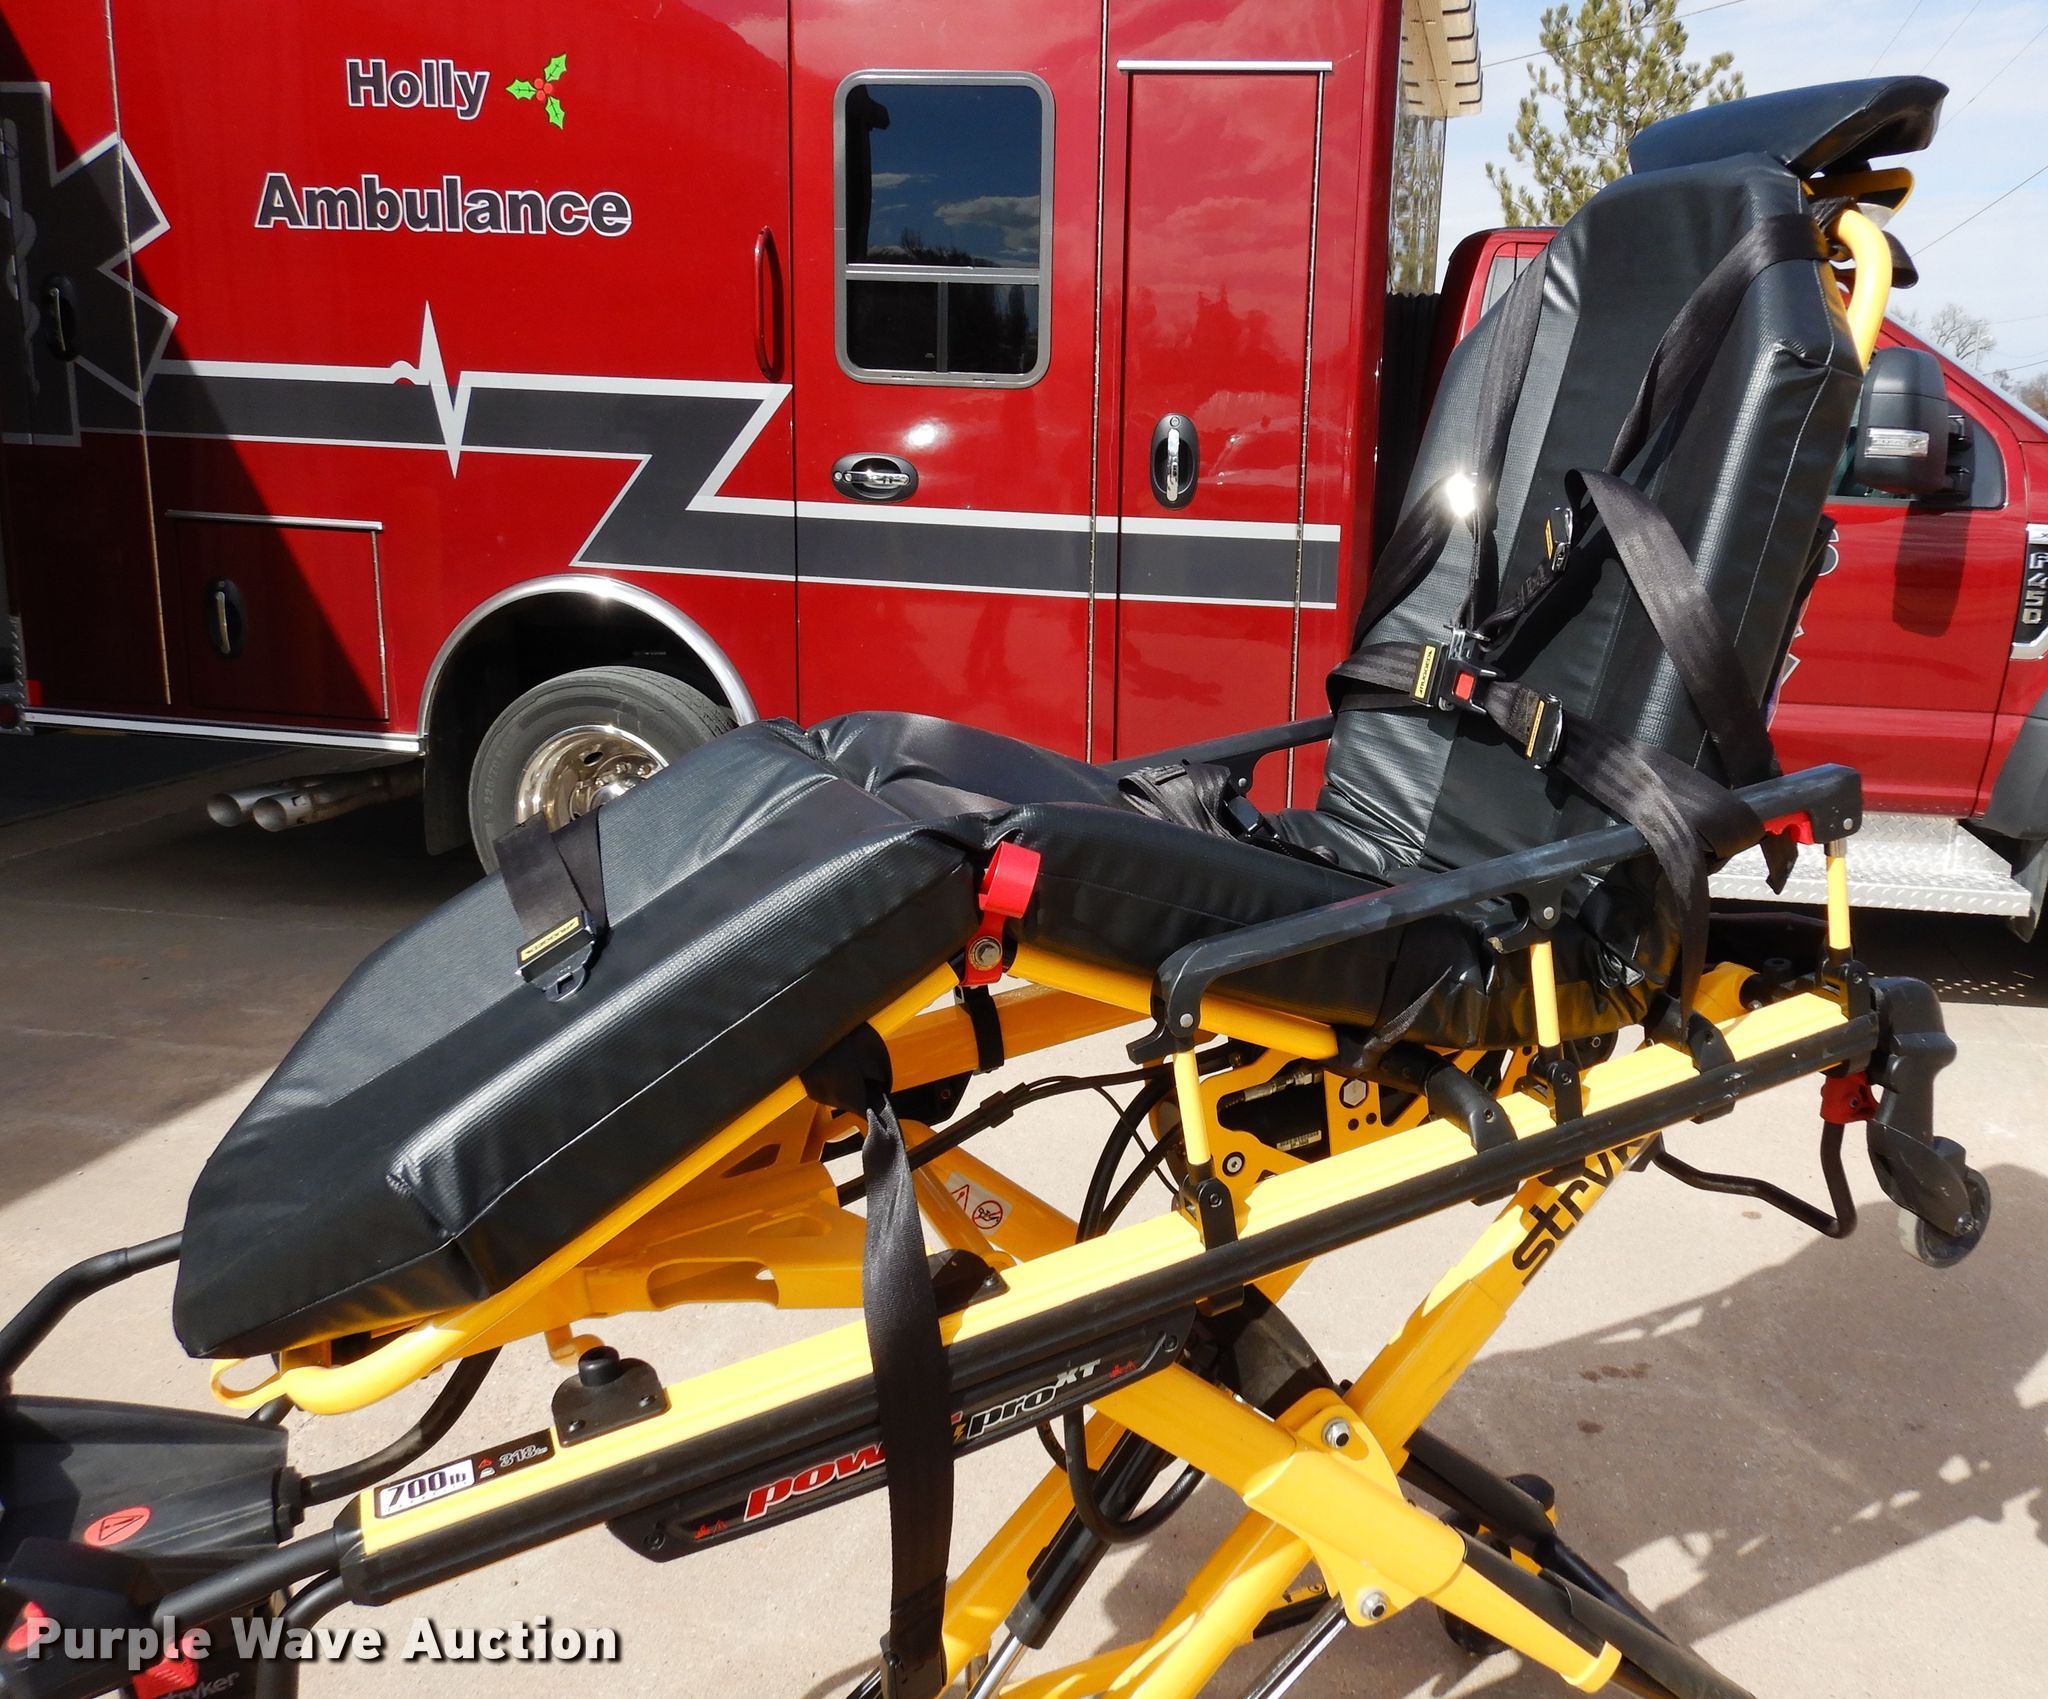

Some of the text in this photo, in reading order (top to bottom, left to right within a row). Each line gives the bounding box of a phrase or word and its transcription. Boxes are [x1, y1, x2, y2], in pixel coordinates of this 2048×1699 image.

[345, 58, 490, 120] Holly
[254, 172, 632, 237] Ambulance
[2021, 552, 2048, 624] F450
[387, 1471, 447, 1508] 700
